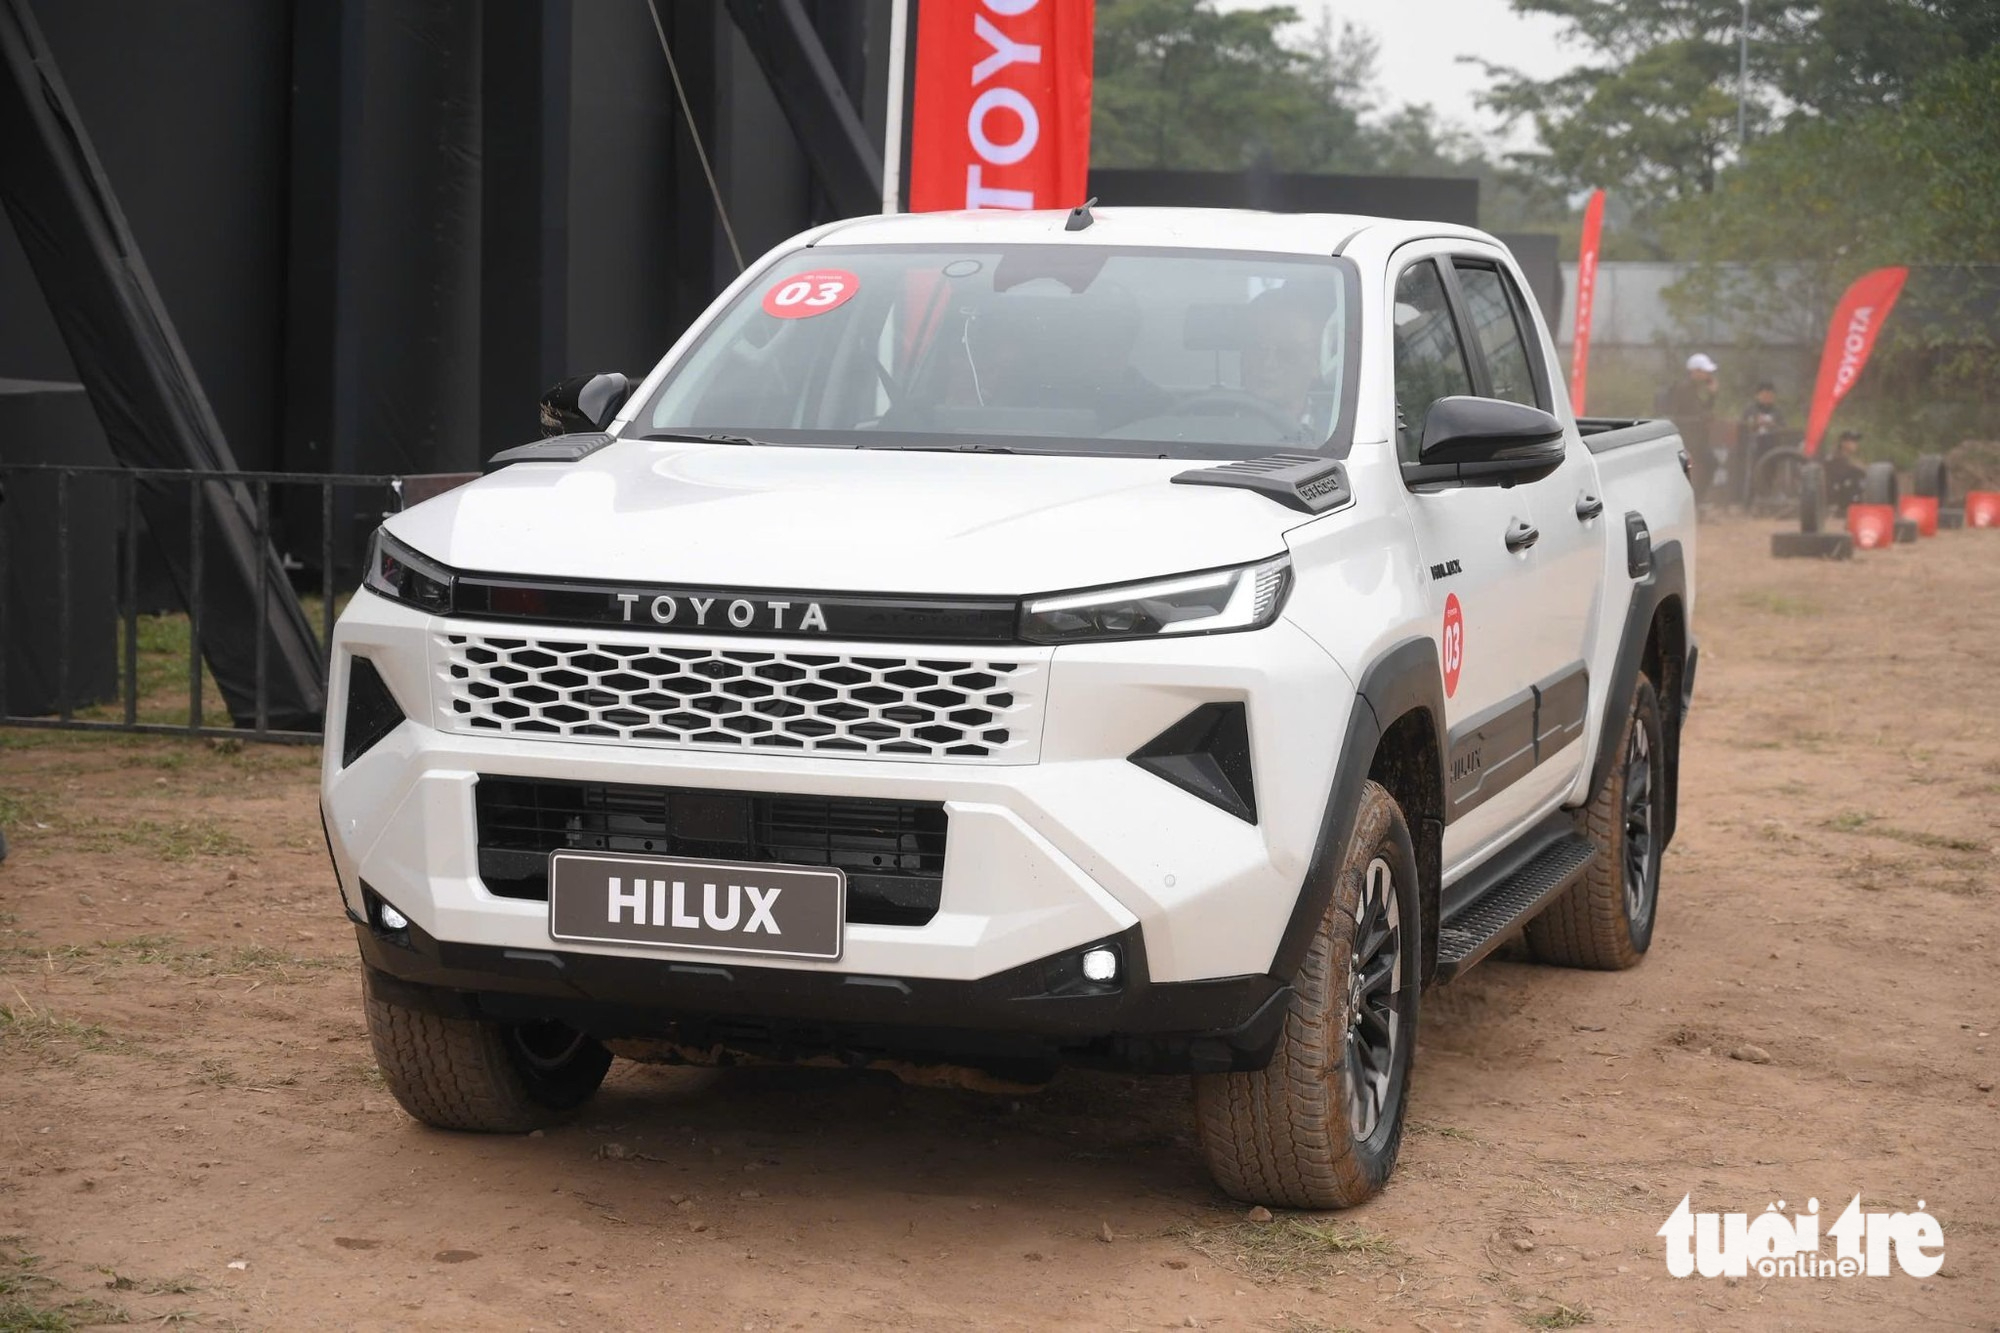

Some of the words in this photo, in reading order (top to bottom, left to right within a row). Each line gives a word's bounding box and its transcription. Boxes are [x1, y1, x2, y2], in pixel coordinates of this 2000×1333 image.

[965, 0, 1042, 210] TOY
[774, 281, 845, 306] 03
[617, 593, 828, 632] TOYOTA
[1445, 622, 1460, 674] 03
[608, 877, 782, 935] HILUX
